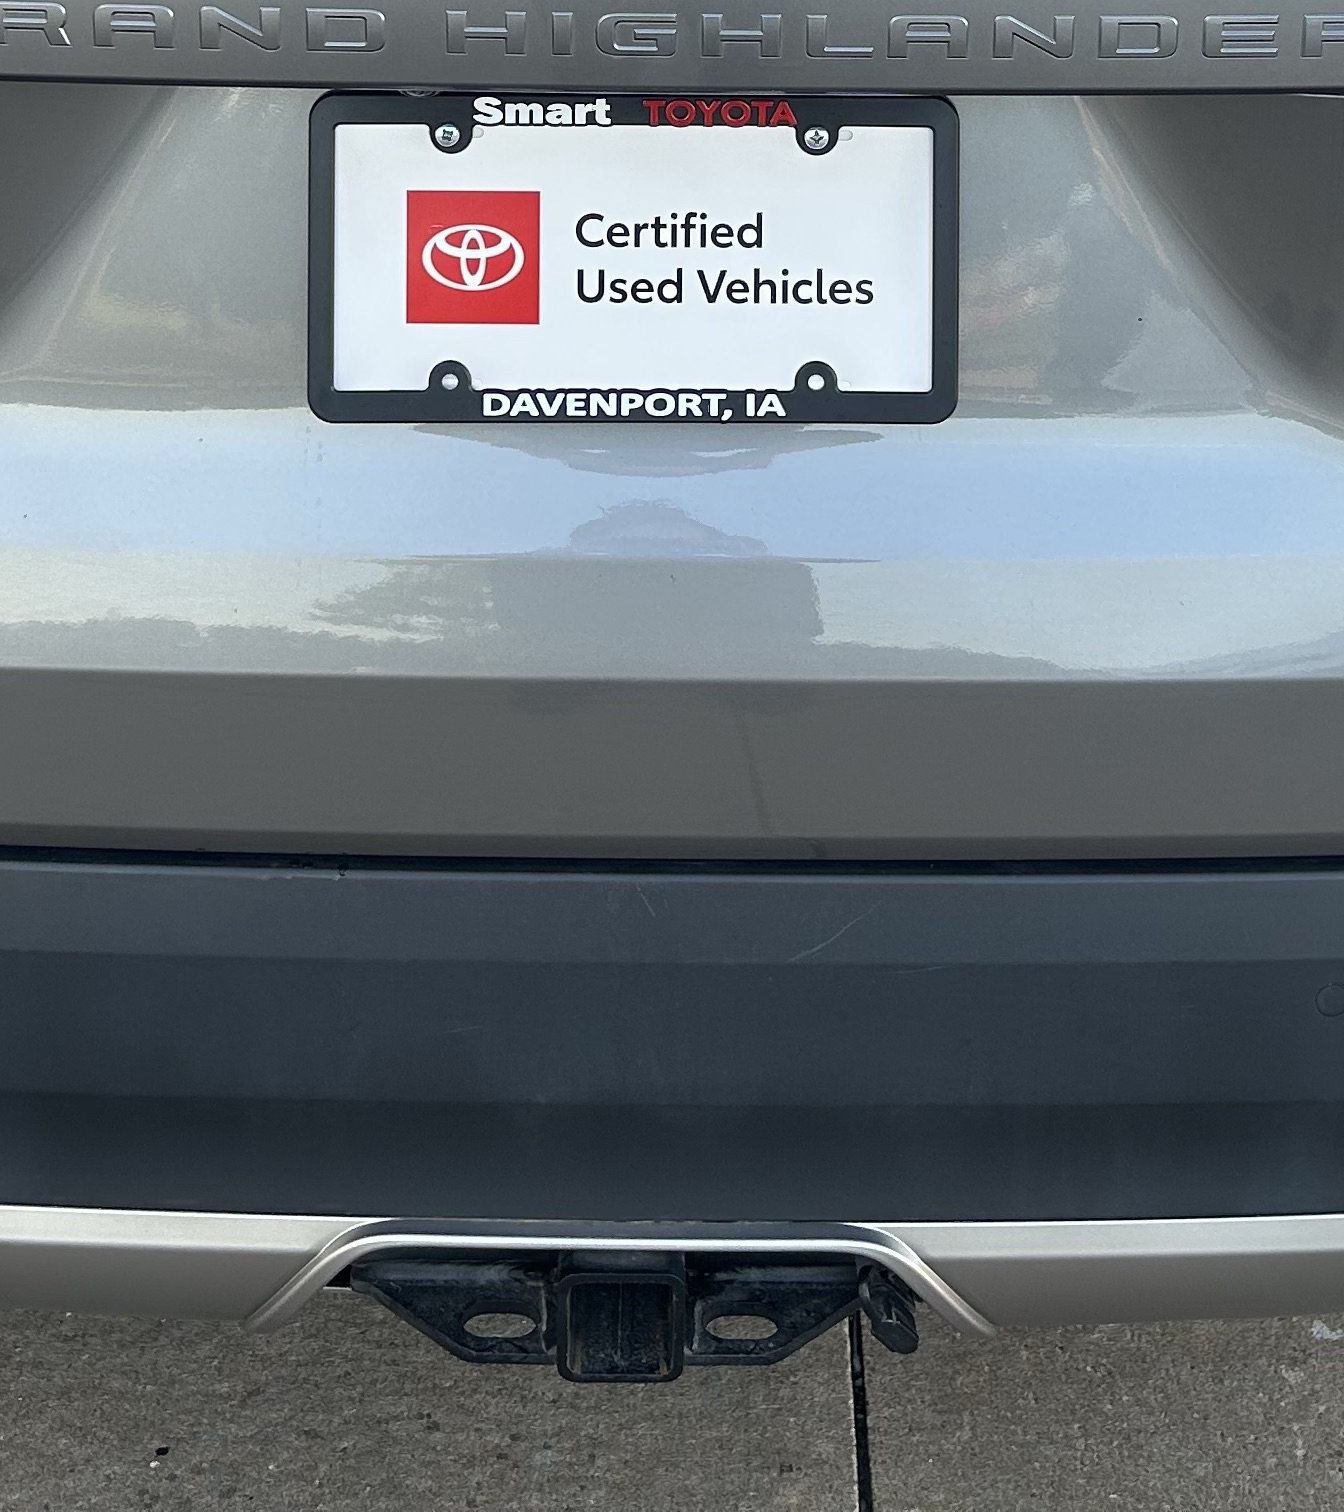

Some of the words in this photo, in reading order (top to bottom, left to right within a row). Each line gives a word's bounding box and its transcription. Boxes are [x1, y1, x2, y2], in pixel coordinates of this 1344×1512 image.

[472, 96, 613, 127] Smart
[643, 98, 798, 128] TOYOTA
[574, 212, 764, 250] Certified
[575, 268, 683, 305] Used
[696, 268, 875, 306] Vehicles
[481, 391, 733, 422] DAVENPORT,
[745, 391, 787, 418] IA
